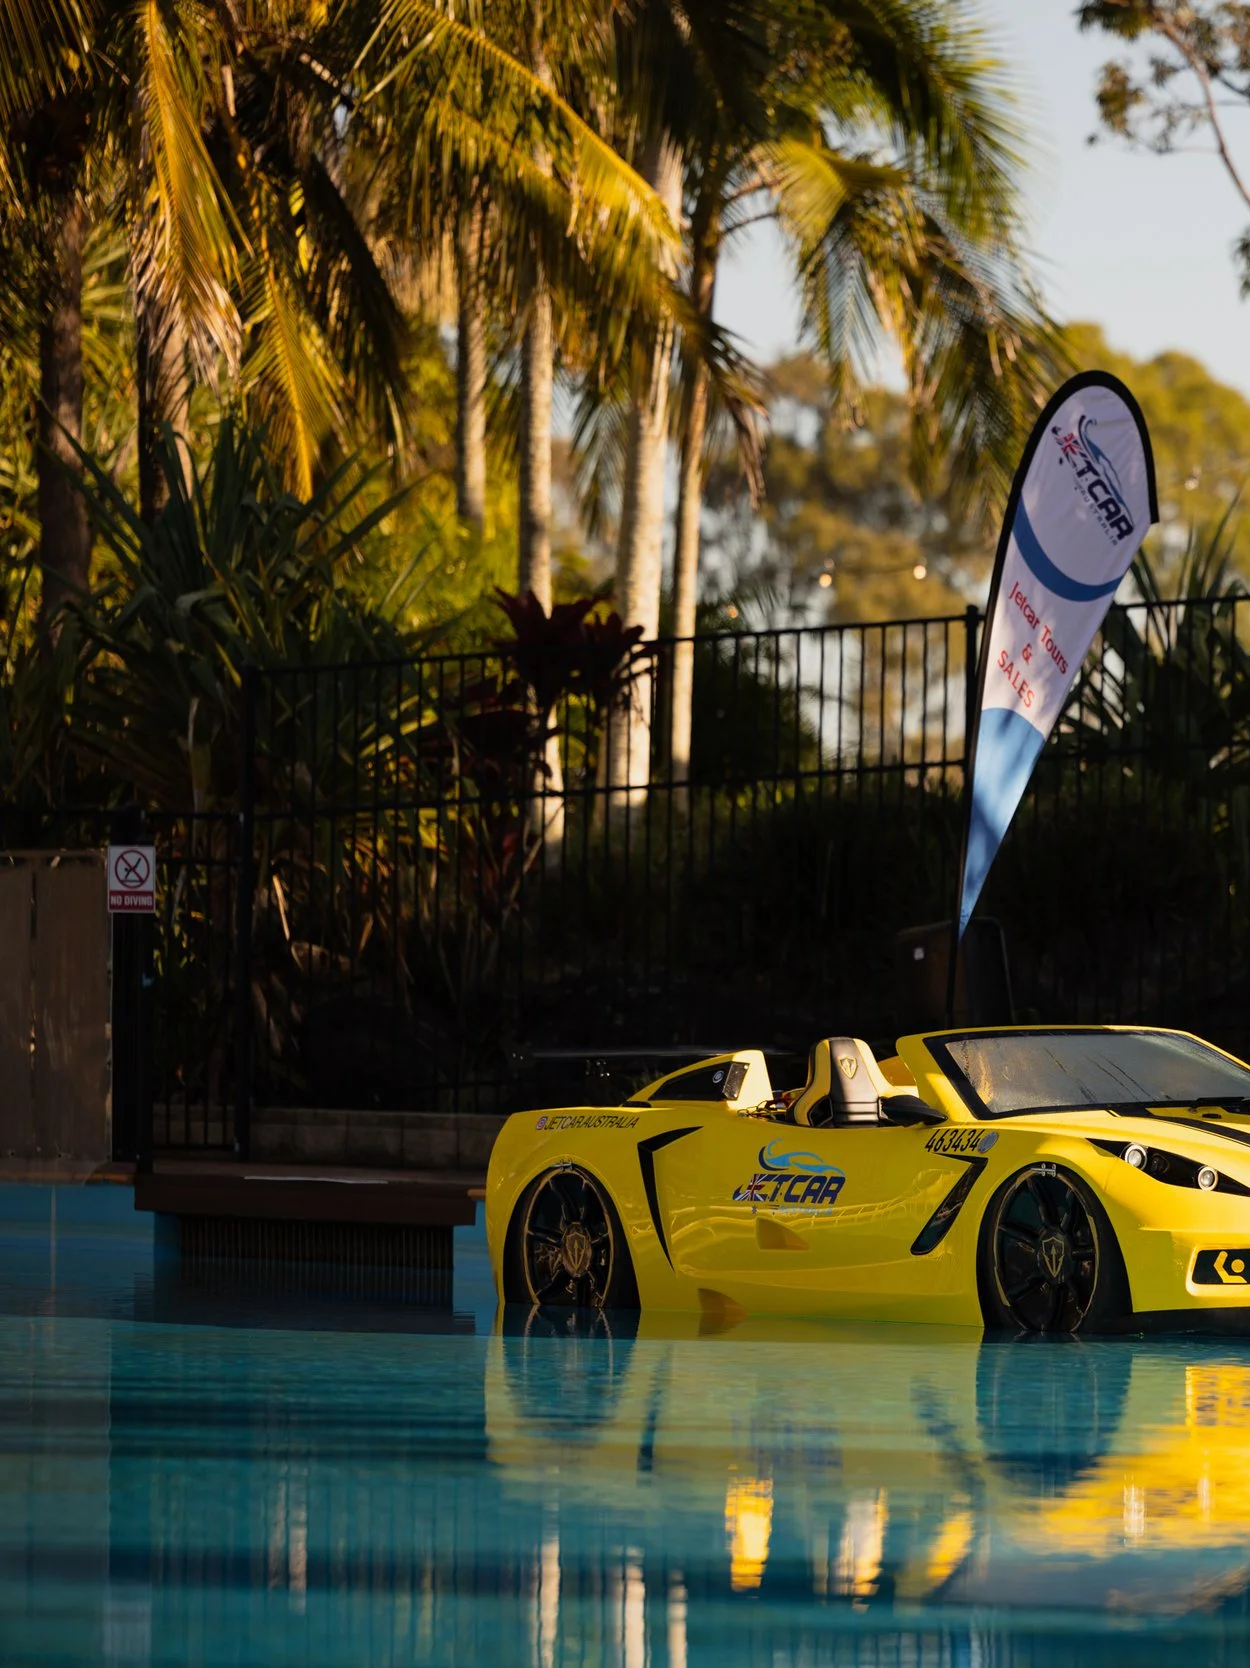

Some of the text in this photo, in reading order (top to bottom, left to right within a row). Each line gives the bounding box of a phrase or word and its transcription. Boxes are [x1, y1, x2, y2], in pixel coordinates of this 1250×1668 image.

[1008, 581, 1041, 630] Jetcar
[1021, 643, 1033, 665] &
[997, 650, 1035, 708] SALES
[110, 895, 153, 907] NO DIVING
[924, 1128, 986, 1152] 463434
[733, 1173, 846, 1205] JETCAR
